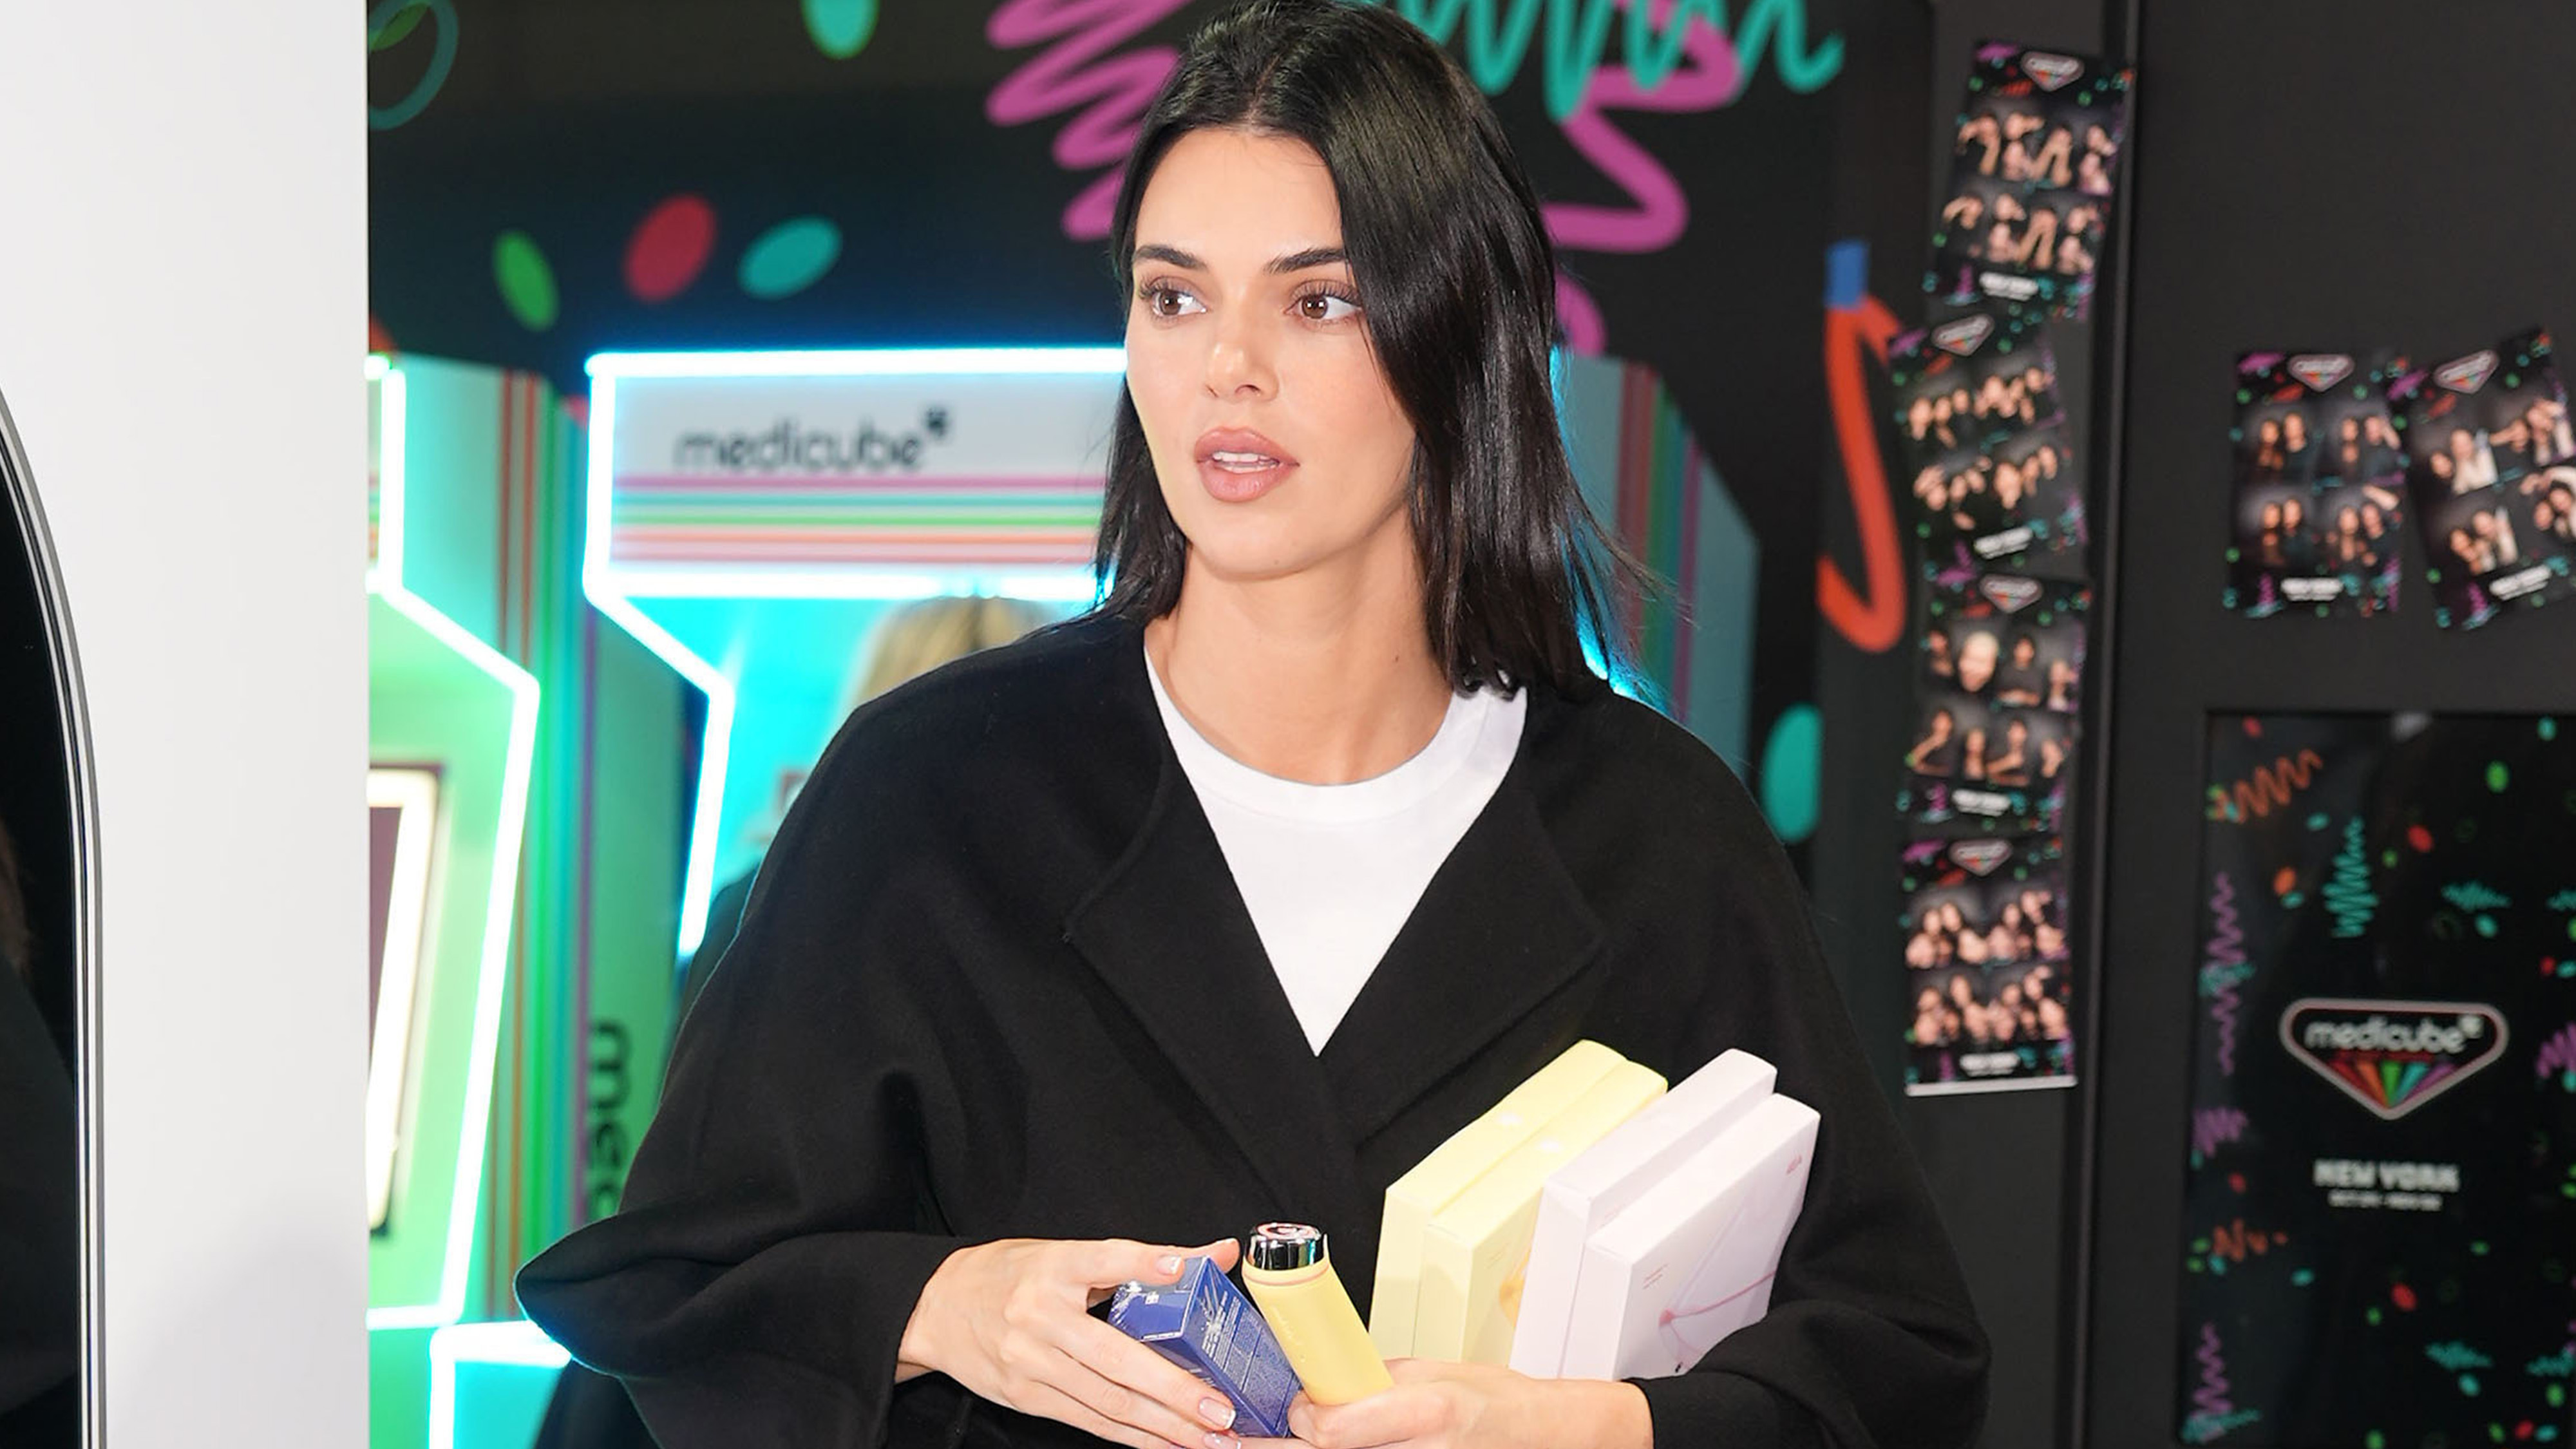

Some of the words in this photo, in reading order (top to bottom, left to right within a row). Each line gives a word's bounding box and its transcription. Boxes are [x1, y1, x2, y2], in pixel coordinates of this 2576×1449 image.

[674, 415, 922, 471] medicube
[2304, 1016, 2465, 1053] medicube
[2315, 1159, 2375, 1188] NEW
[2380, 1161, 2459, 1192] YORK
